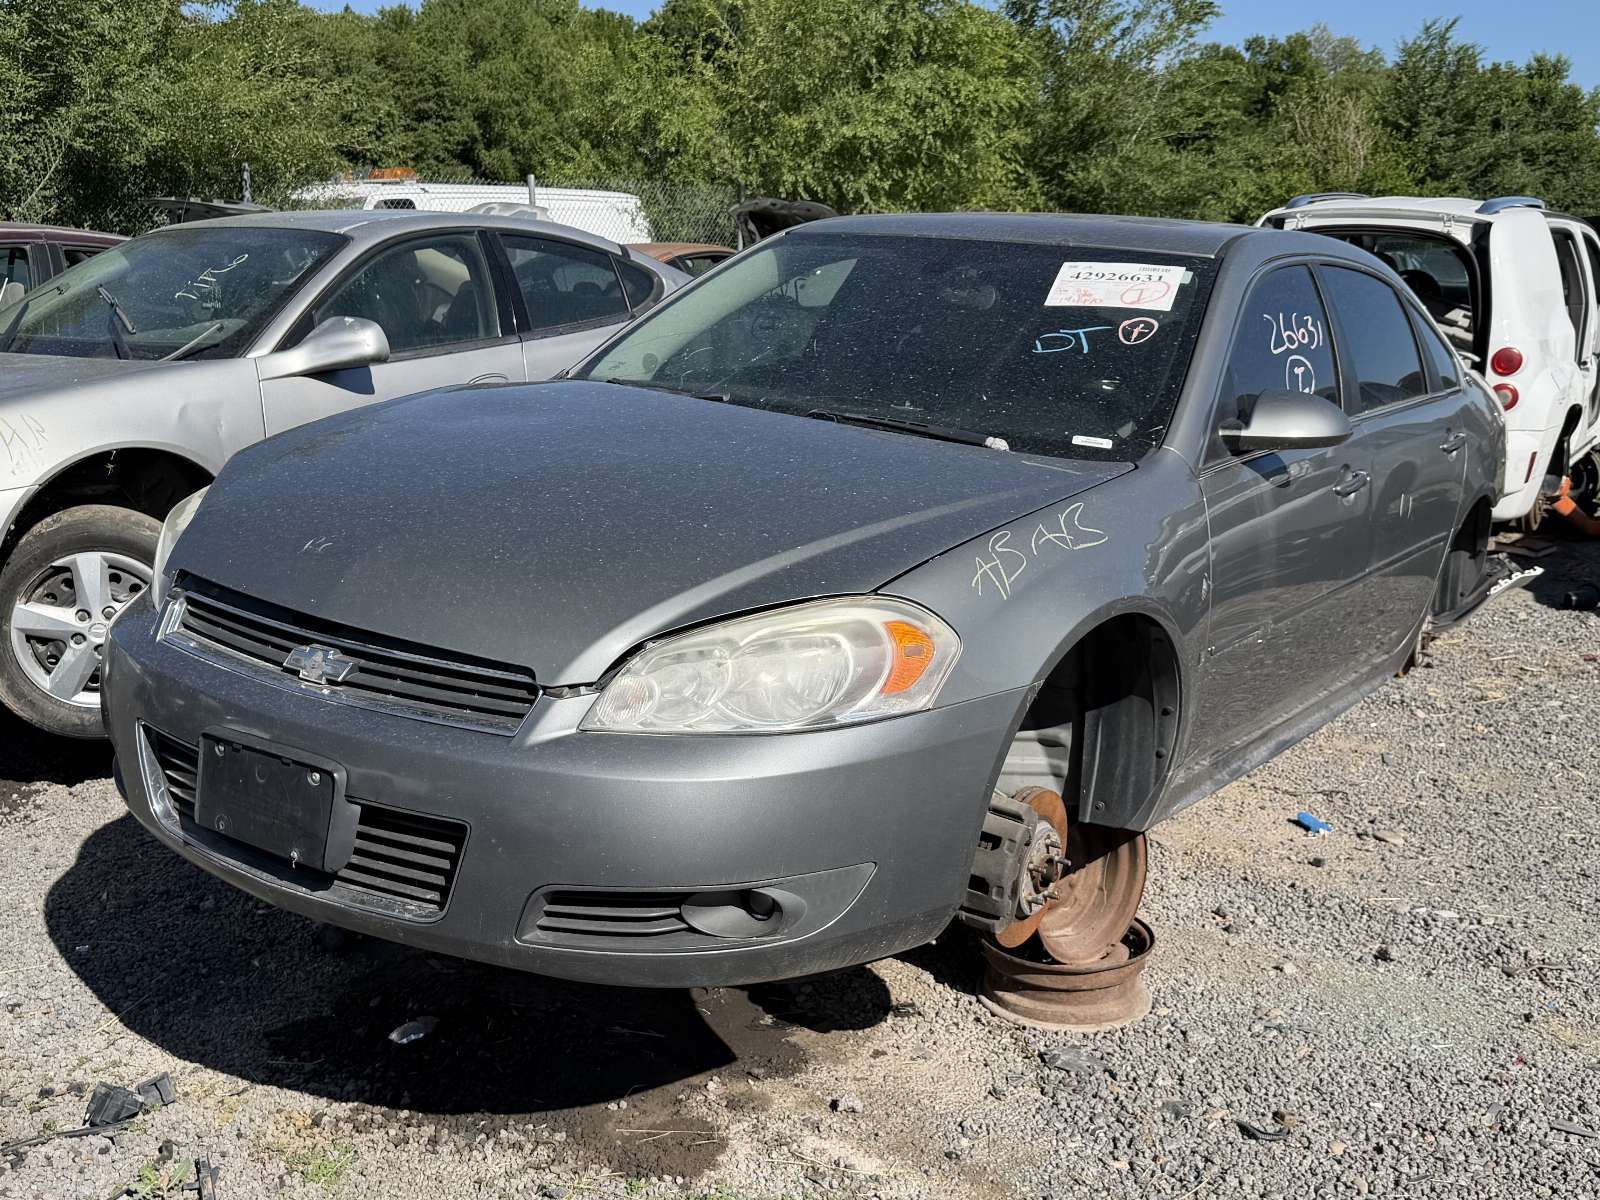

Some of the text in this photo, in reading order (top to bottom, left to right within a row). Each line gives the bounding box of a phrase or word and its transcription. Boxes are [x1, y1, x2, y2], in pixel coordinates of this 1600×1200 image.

[1069, 271, 1164, 282] 42926631
[1032, 326, 1113, 354] DT
[1262, 312, 1323, 355] 26631
